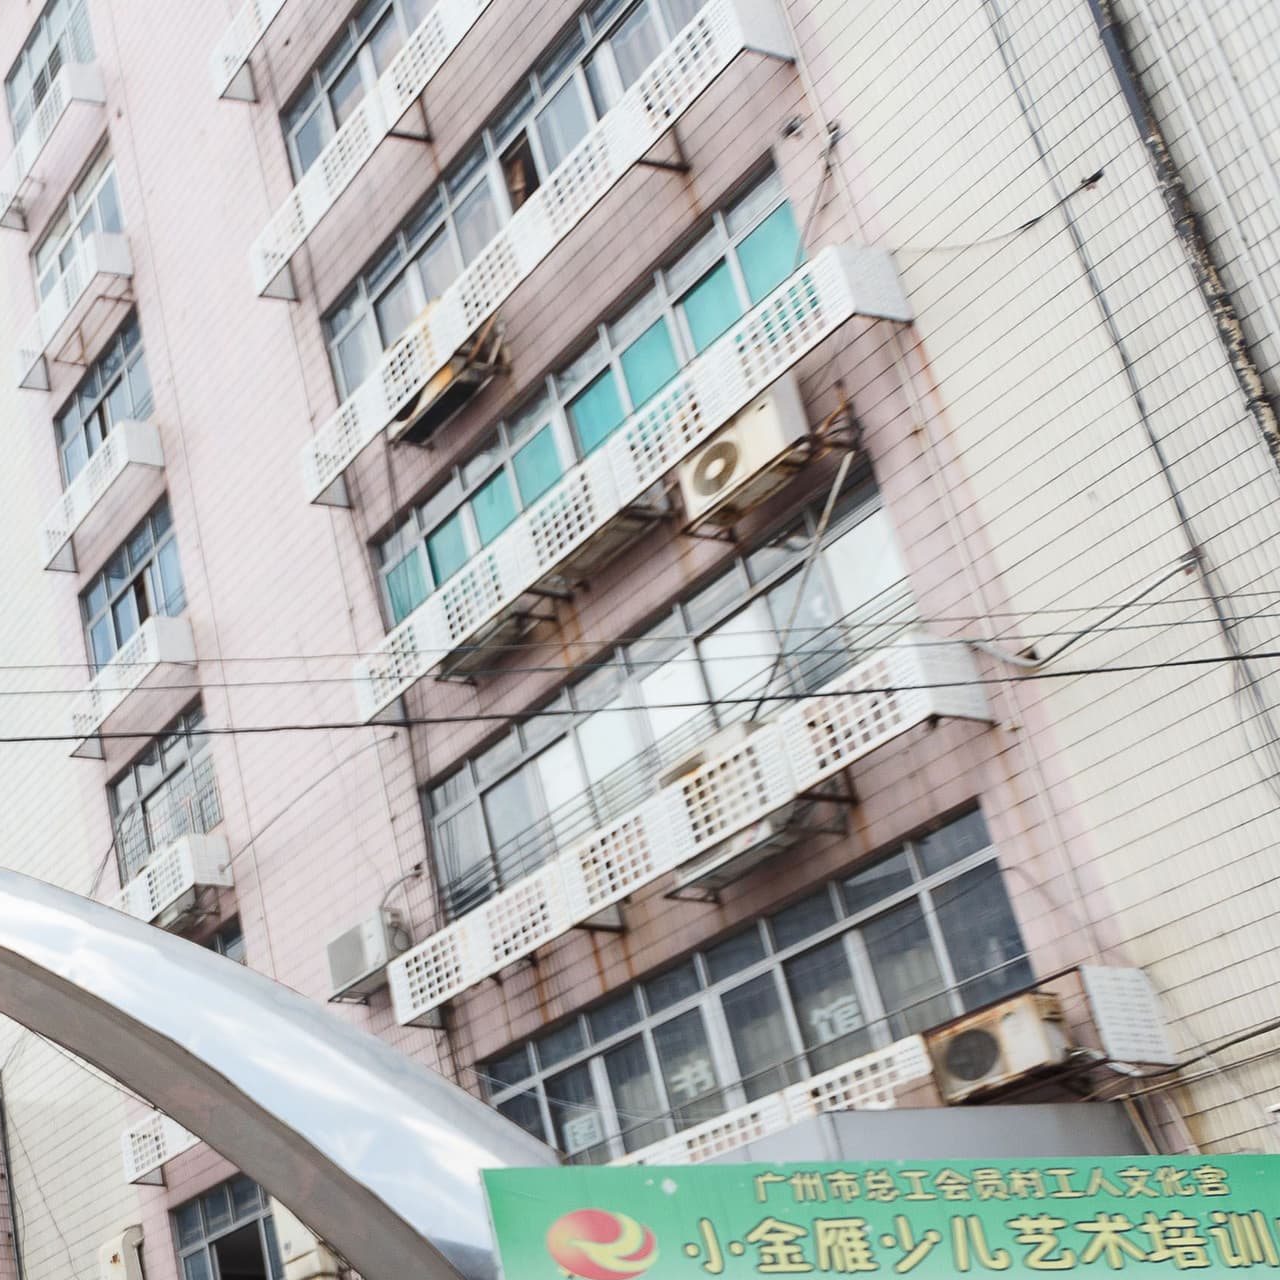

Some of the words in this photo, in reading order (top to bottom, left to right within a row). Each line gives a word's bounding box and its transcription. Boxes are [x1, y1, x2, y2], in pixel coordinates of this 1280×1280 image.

[755, 1164, 1231, 1202] 广州市总工会员村工人文化宫
